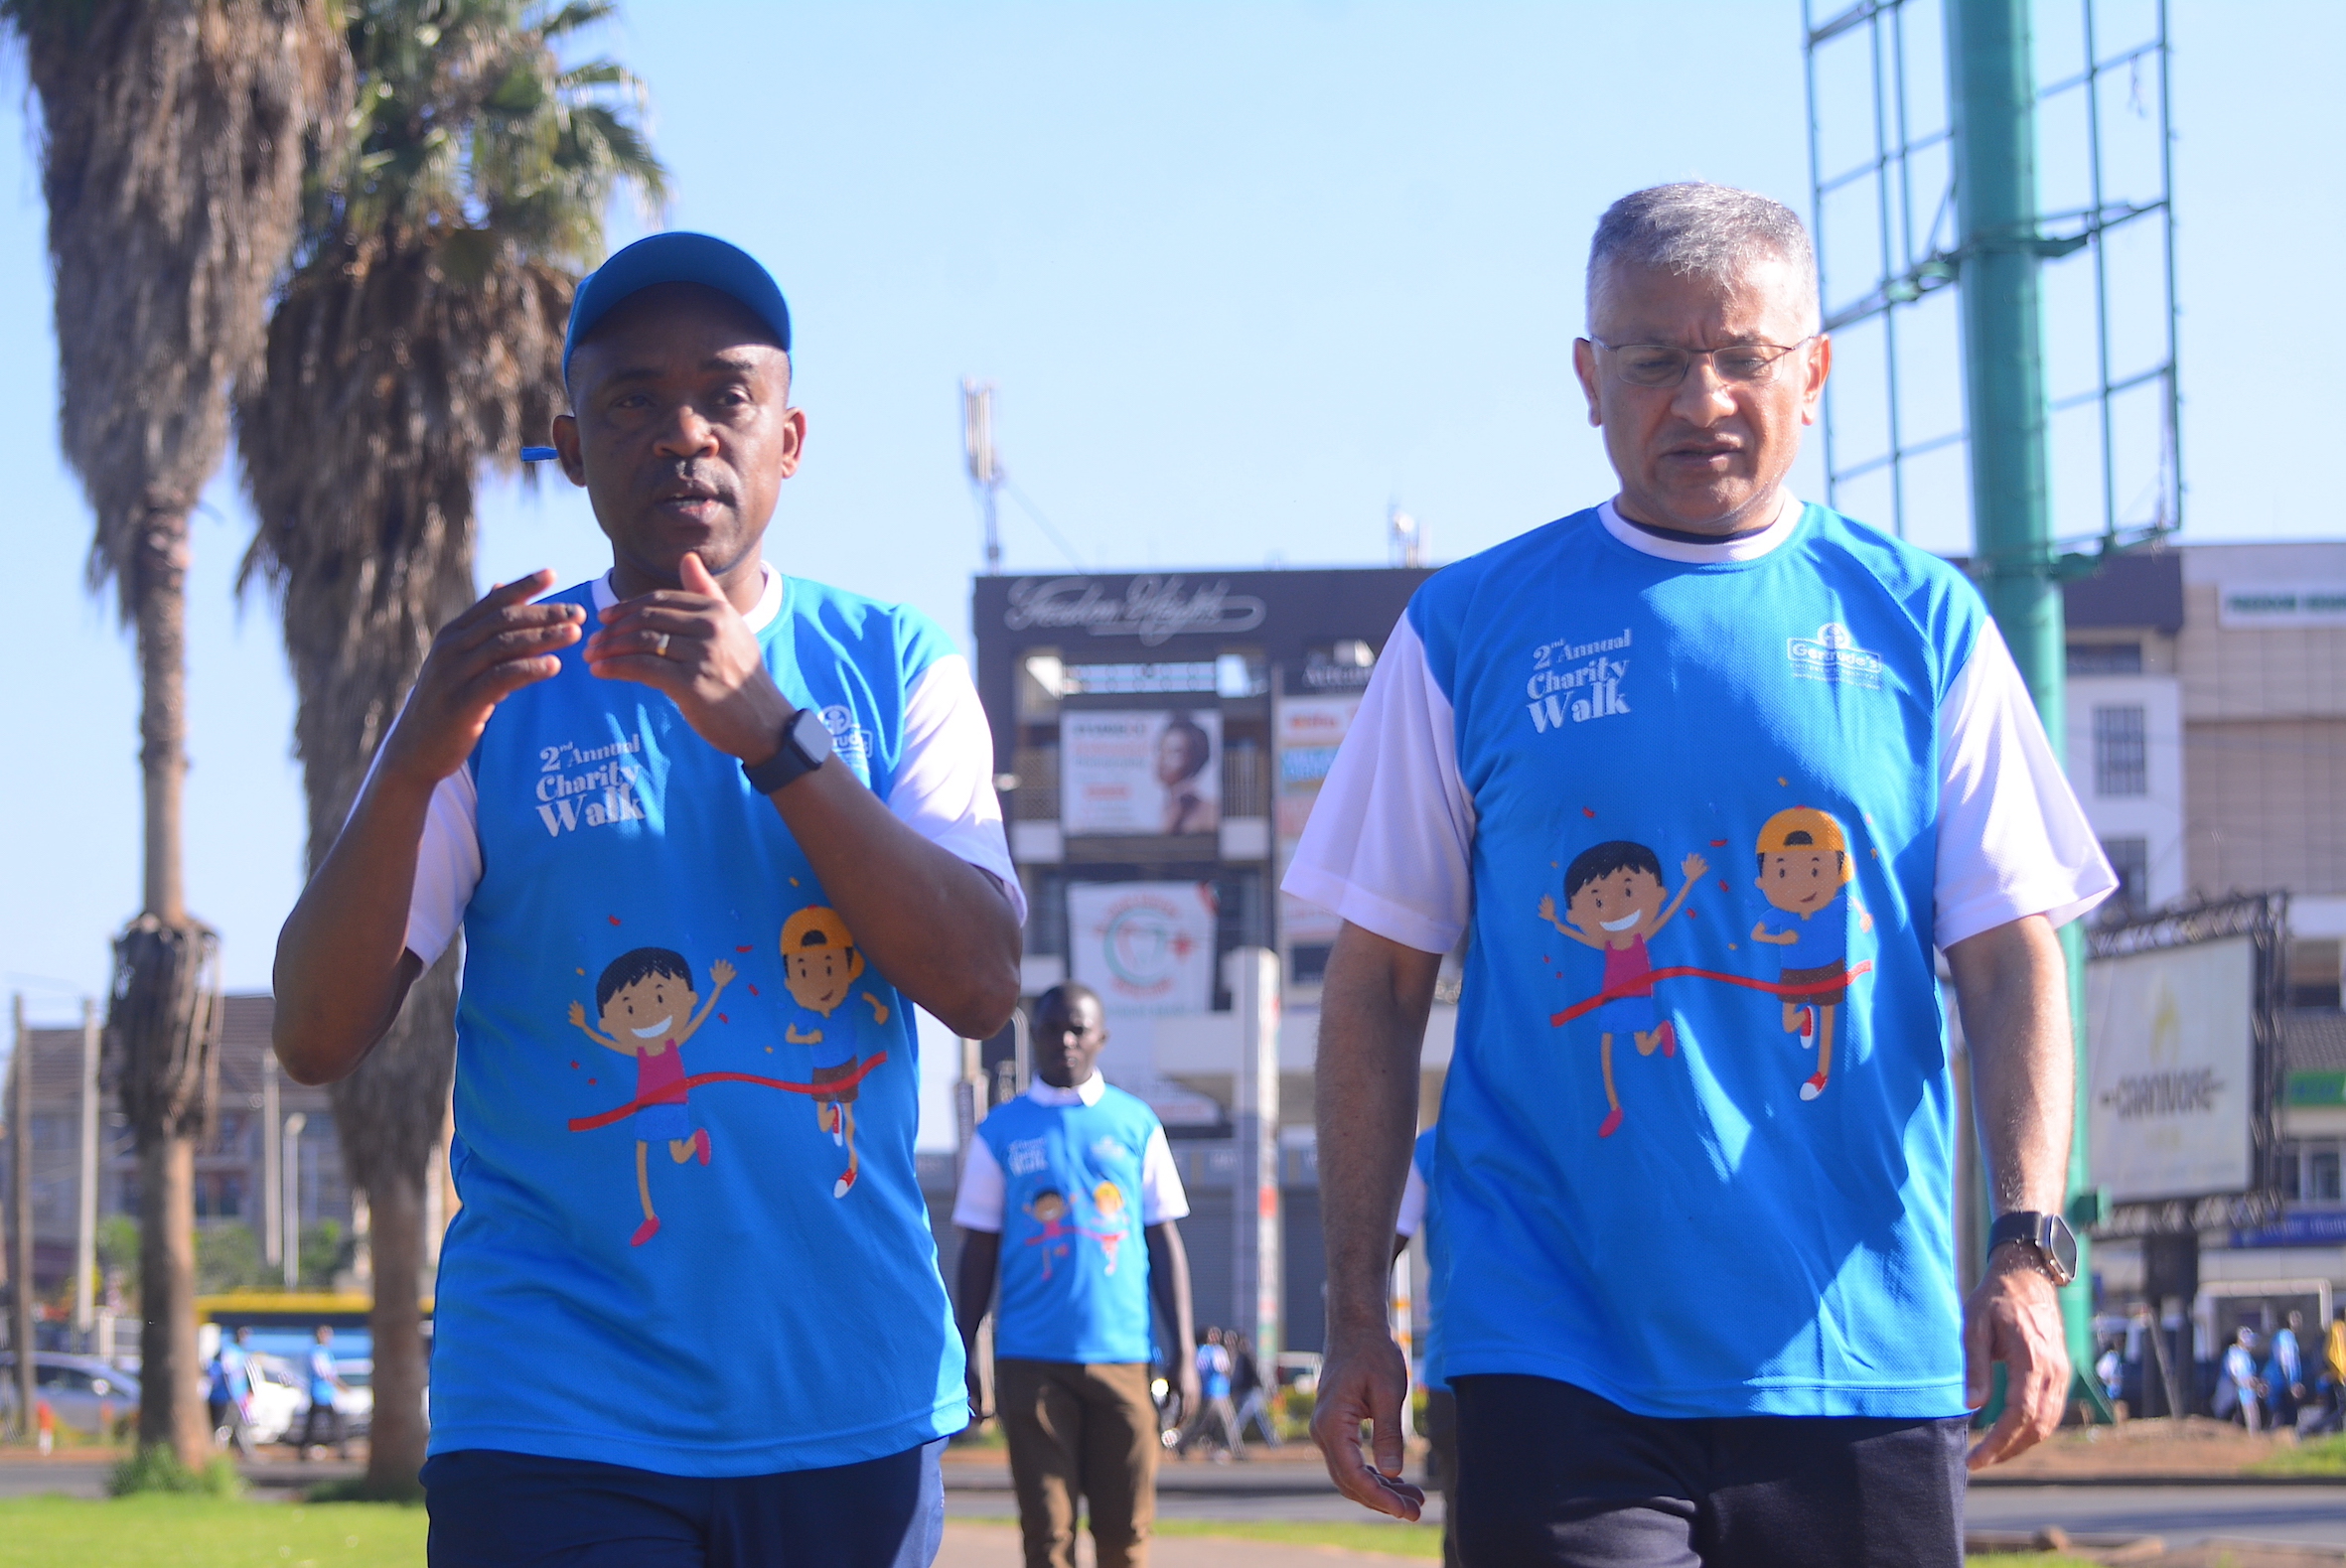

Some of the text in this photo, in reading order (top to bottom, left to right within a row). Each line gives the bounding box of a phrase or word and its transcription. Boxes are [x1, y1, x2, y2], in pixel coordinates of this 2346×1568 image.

[1556, 629, 1632, 663] Annual
[1527, 656, 1630, 700] Charity
[1526, 677, 1631, 734] Walk
[567, 733, 641, 768] Annual
[535, 761, 641, 802] Charity
[535, 782, 646, 838] Walk
